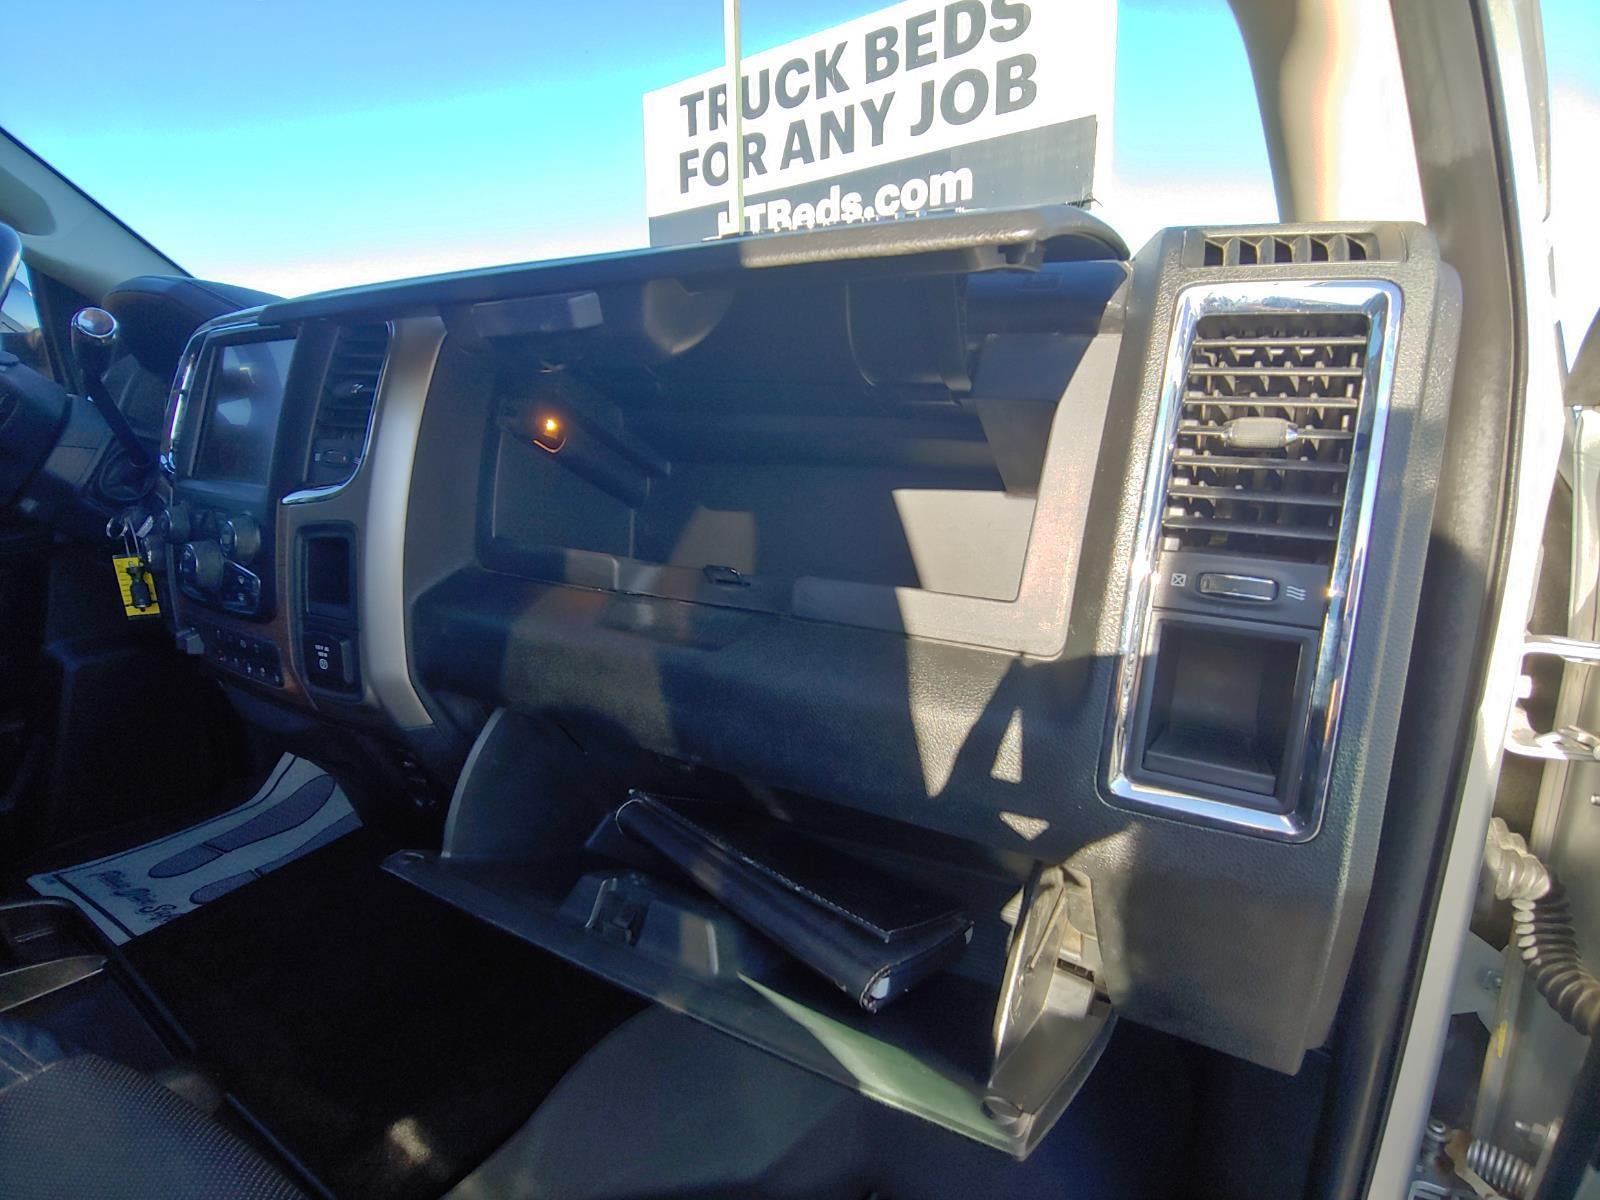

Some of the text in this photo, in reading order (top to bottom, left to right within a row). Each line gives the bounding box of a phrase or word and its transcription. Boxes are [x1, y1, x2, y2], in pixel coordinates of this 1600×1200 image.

[680, 0, 1032, 137] TRUCK BEDS
[680, 53, 1038, 194] FOR ANY JOB
